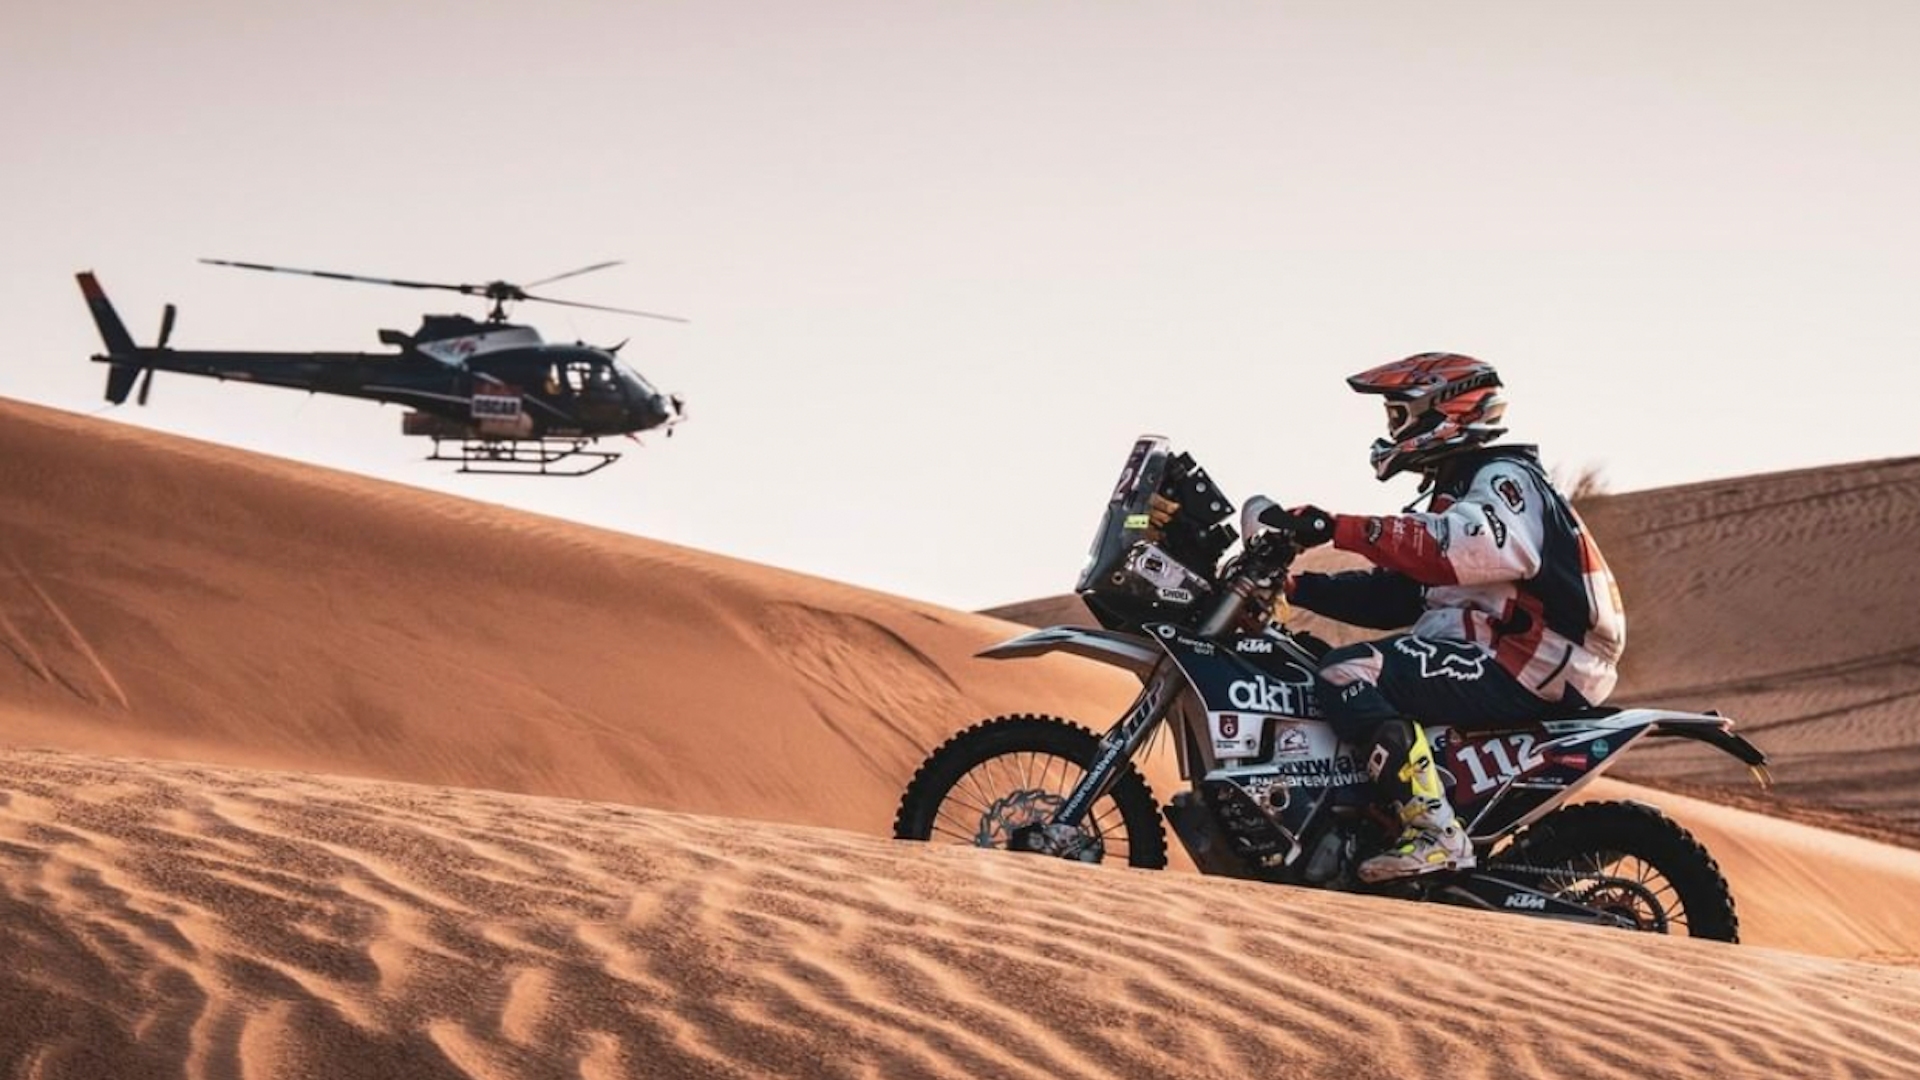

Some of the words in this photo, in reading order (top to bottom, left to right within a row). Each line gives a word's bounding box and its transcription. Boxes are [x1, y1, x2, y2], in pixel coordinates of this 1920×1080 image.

[1236, 639, 1273, 653] KTM
[1228, 675, 1295, 715] akt
[1341, 681, 1365, 702] FOX
[1456, 733, 1545, 795] 112
[1505, 893, 1546, 910] KTM
